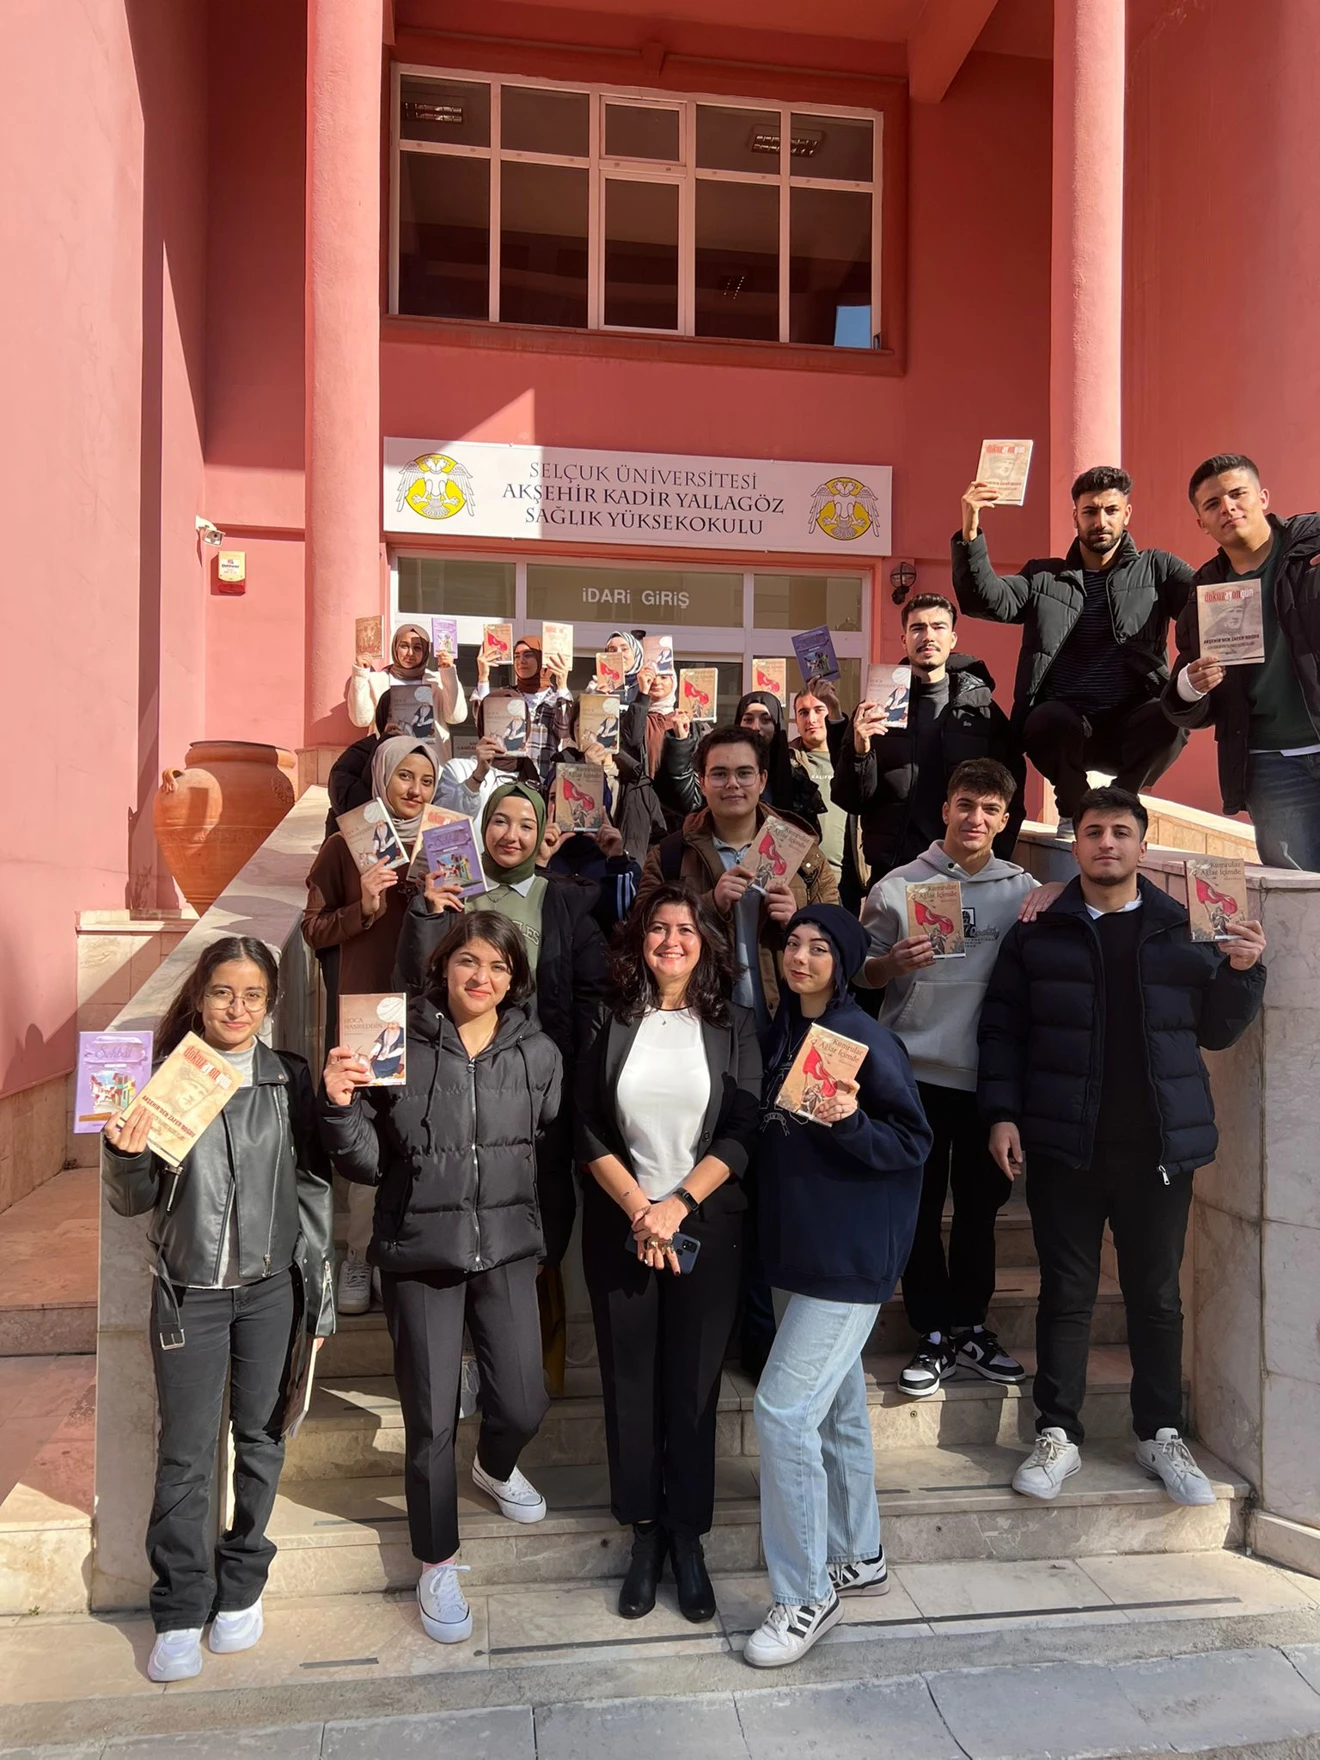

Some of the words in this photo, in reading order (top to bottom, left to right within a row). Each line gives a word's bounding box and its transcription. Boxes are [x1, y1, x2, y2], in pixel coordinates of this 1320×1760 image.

[529, 462, 610, 483] SELÇUK
[616, 464, 758, 490] ÜNİVERSİTESİ
[502, 483, 598, 504] AKŞEHİR
[603, 488, 671, 508] KADİR
[675, 494, 785, 514] YALLAGÖZ
[525, 505, 603, 527] SAĞLIK
[607, 509, 763, 535] YÜKSEKOKULU
[832, 1039, 863, 1056] Kumrular
